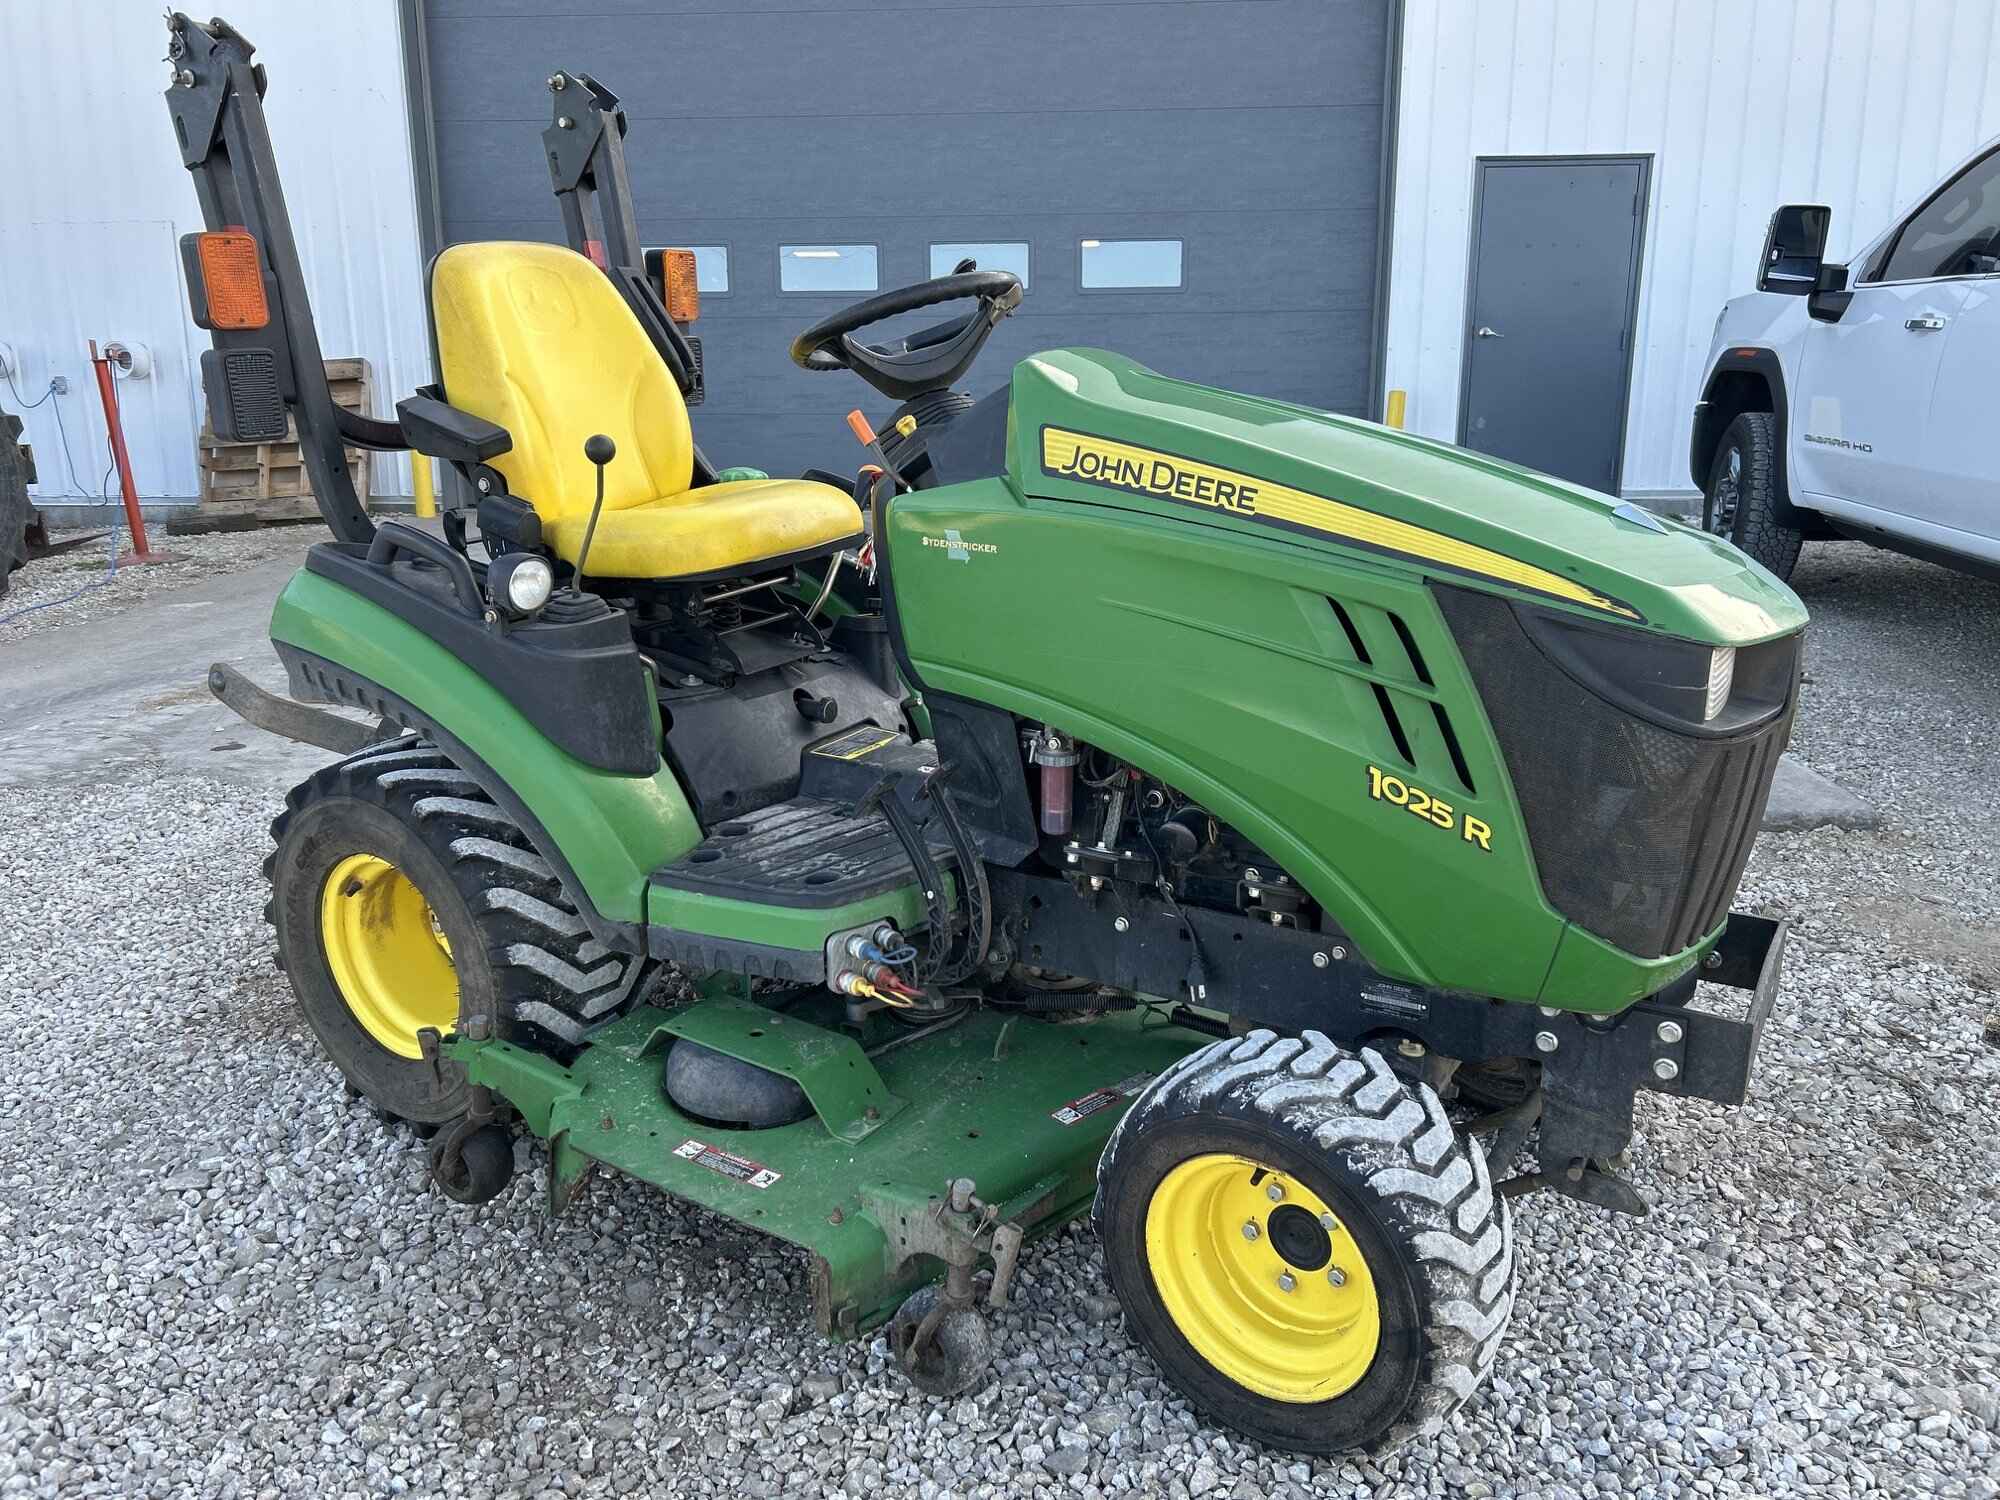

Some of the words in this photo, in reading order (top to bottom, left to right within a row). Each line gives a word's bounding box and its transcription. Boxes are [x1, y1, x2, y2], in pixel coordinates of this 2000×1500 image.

[1852, 441, 1873, 453] HD
[1062, 445, 1145, 485] JOHN
[1150, 460, 1259, 512] DEERE
[922, 536, 998, 554] SYDENSTRICKER
